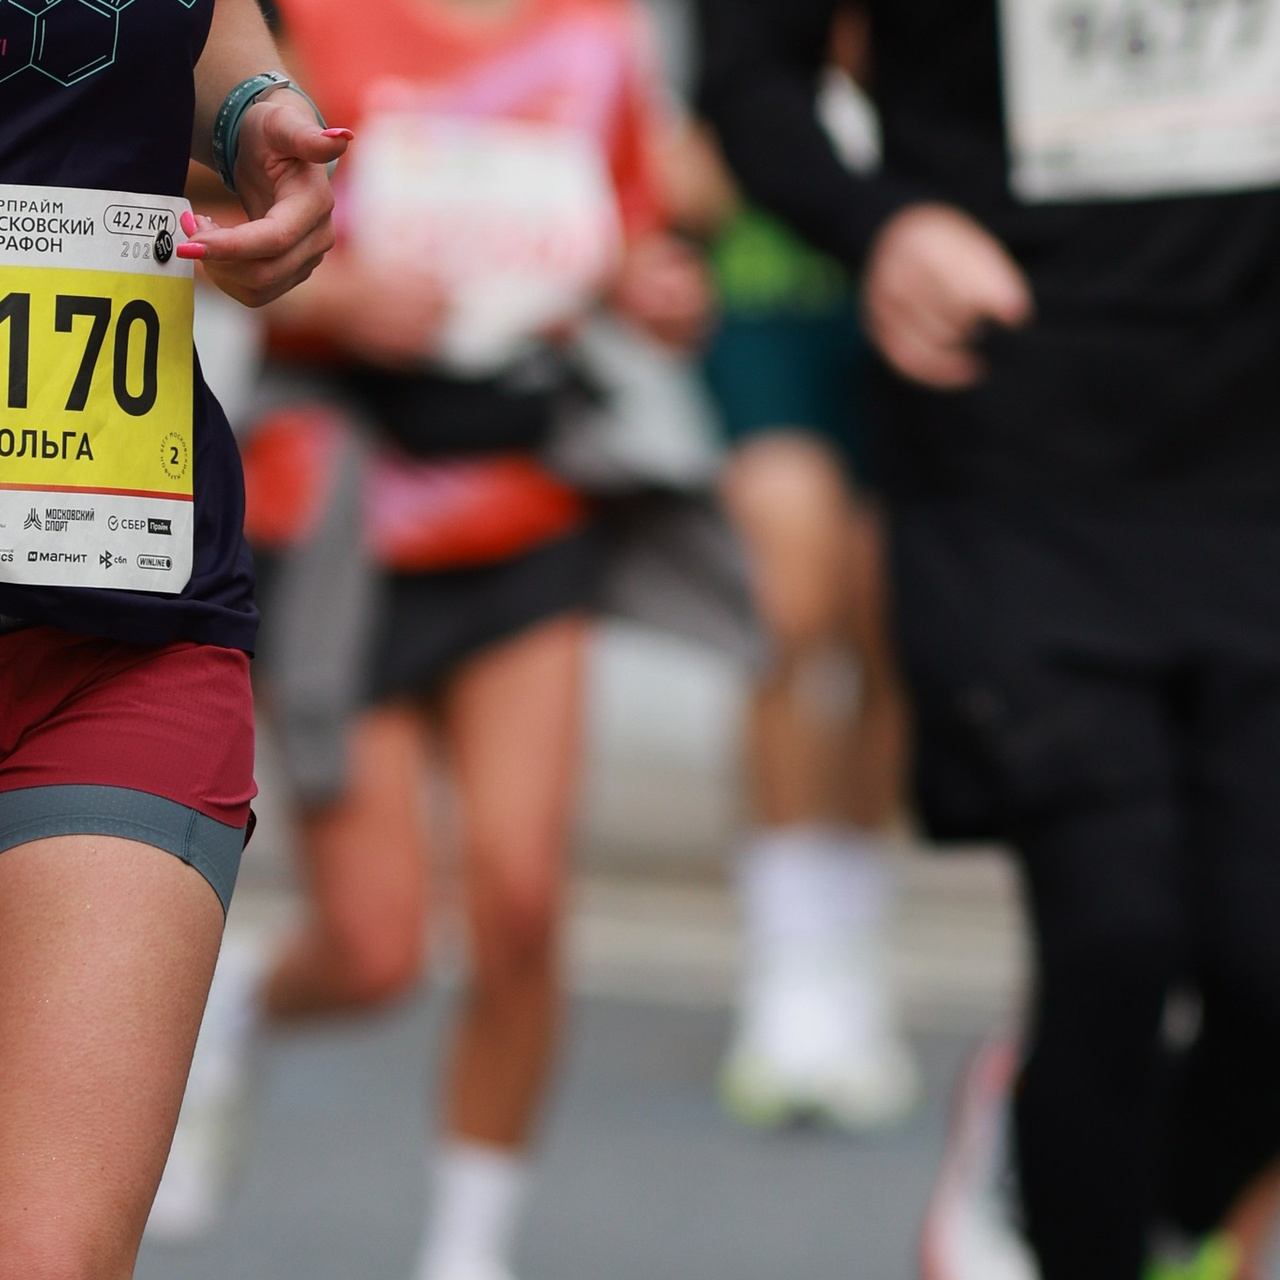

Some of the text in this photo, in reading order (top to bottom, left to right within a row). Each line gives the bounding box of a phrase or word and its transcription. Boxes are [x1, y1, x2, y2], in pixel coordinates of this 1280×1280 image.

[112, 211, 144, 231] 42,2
[120, 241, 151, 260] 202
[160, 234, 172, 255] 10
[170, 446, 179, 465] 2
[45, 508, 95, 521] МОСКОВСКИЙ
[45, 521, 68, 532] СПОРТ
[121, 519, 169, 531] СБЕР Прайм
[114, 556, 127, 564] сбп
[139, 557, 165, 567] WINLINE
